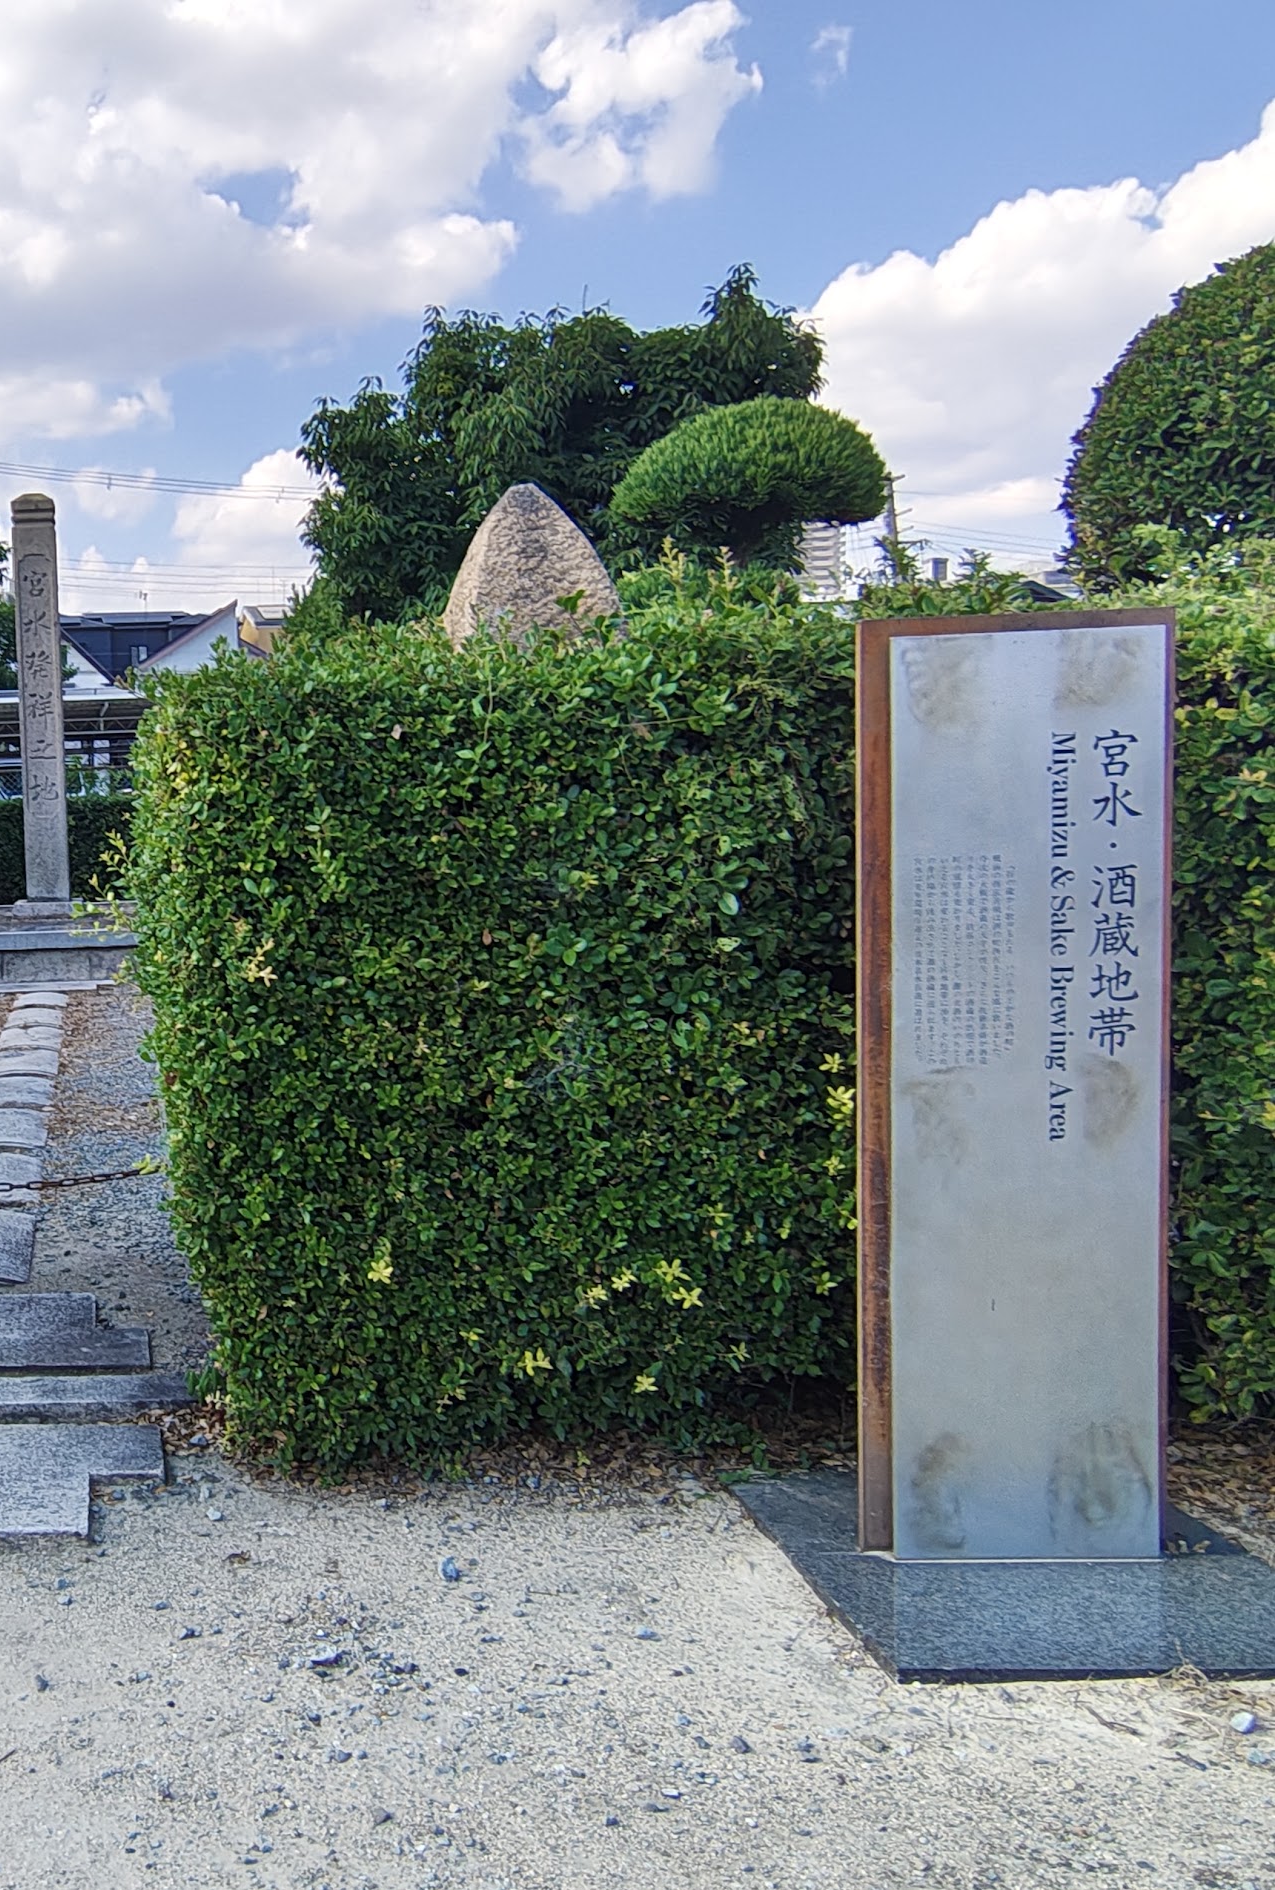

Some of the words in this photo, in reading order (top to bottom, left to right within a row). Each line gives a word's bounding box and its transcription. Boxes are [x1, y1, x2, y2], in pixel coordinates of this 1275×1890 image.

[1047, 732, 1077, 858] Miyamizu
[1051, 866, 1076, 890] &
[1088, 729, 1143, 1056] 宮水・酒蔵地帯
[1050, 895, 1076, 957] Sake
[1045, 965, 1075, 1072] Brewing
[1049, 1080, 1074, 1142] Area
